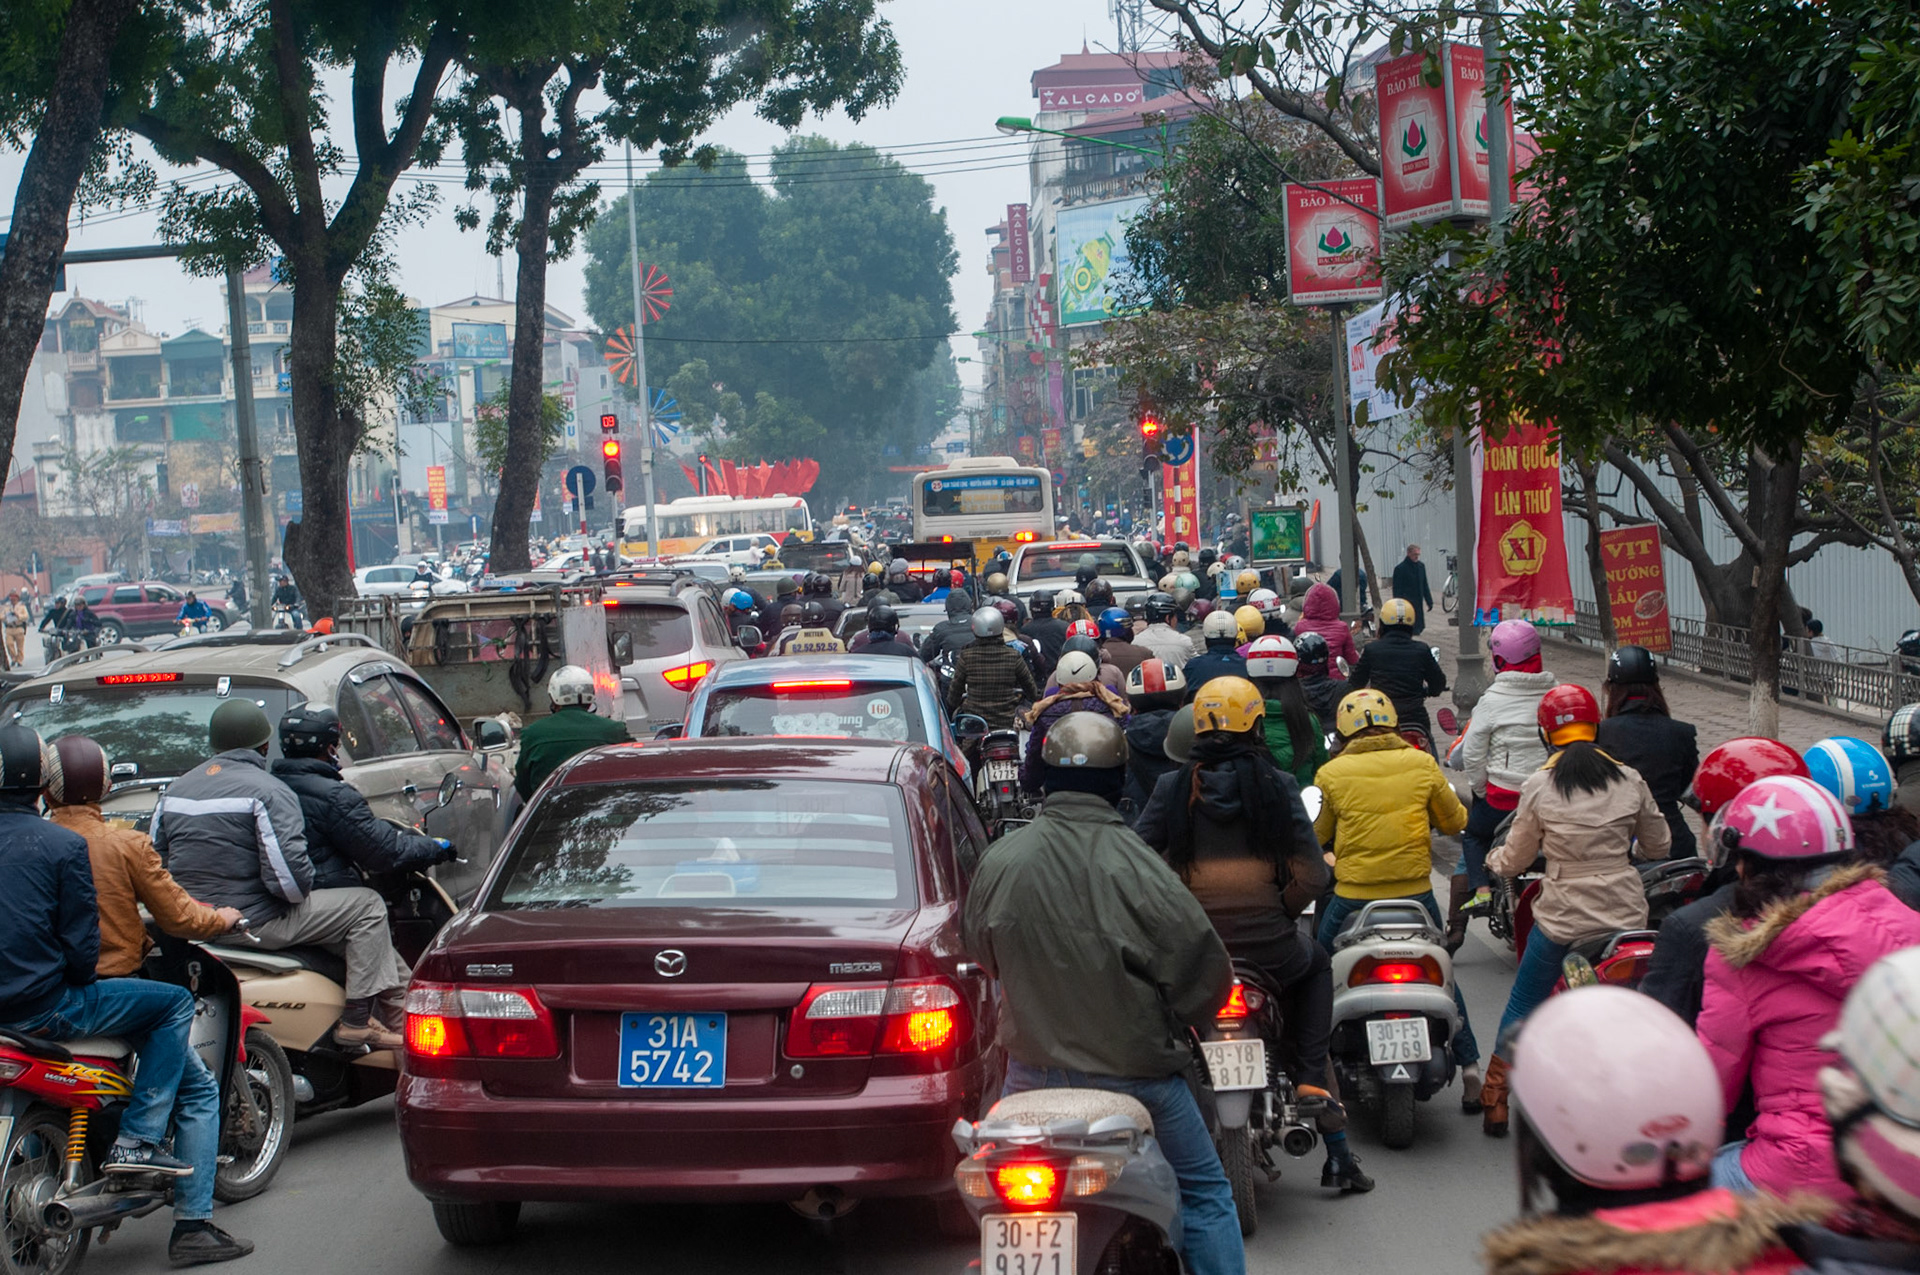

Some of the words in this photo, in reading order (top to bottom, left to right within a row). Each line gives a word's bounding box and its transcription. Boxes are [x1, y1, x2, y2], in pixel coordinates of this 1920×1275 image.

[1461, 63, 1479, 80] BẢO
[1387, 76, 1406, 96] BẢO
[1058, 92, 1137, 105] ALCADO
[1300, 194, 1326, 208] BẢO
[1013, 221, 1024, 272] ALCADO
[602, 416, 615, 428] 09
[1494, 483, 1520, 516] LẦN
[1523, 482, 1552, 515] THỨ
[1508, 537, 1535, 561] XI
[1605, 539, 1653, 560] VỊT
[871, 704, 890, 715] 160
[466, 964, 513, 976] 626
[829, 962, 882, 974] mazda
[251, 1000, 306, 1010] LEAD
[648, 1016, 698, 1048] 31A
[1376, 1021, 1419, 1041] 30-F5
[1206, 1045, 1254, 1066] 29-Y8
[1379, 1041, 1422, 1061] 2769
[631, 1050, 713, 1083] 5742
[997, 1220, 1062, 1249] 30-F2
[996, 1252, 1060, 1275] 9371
